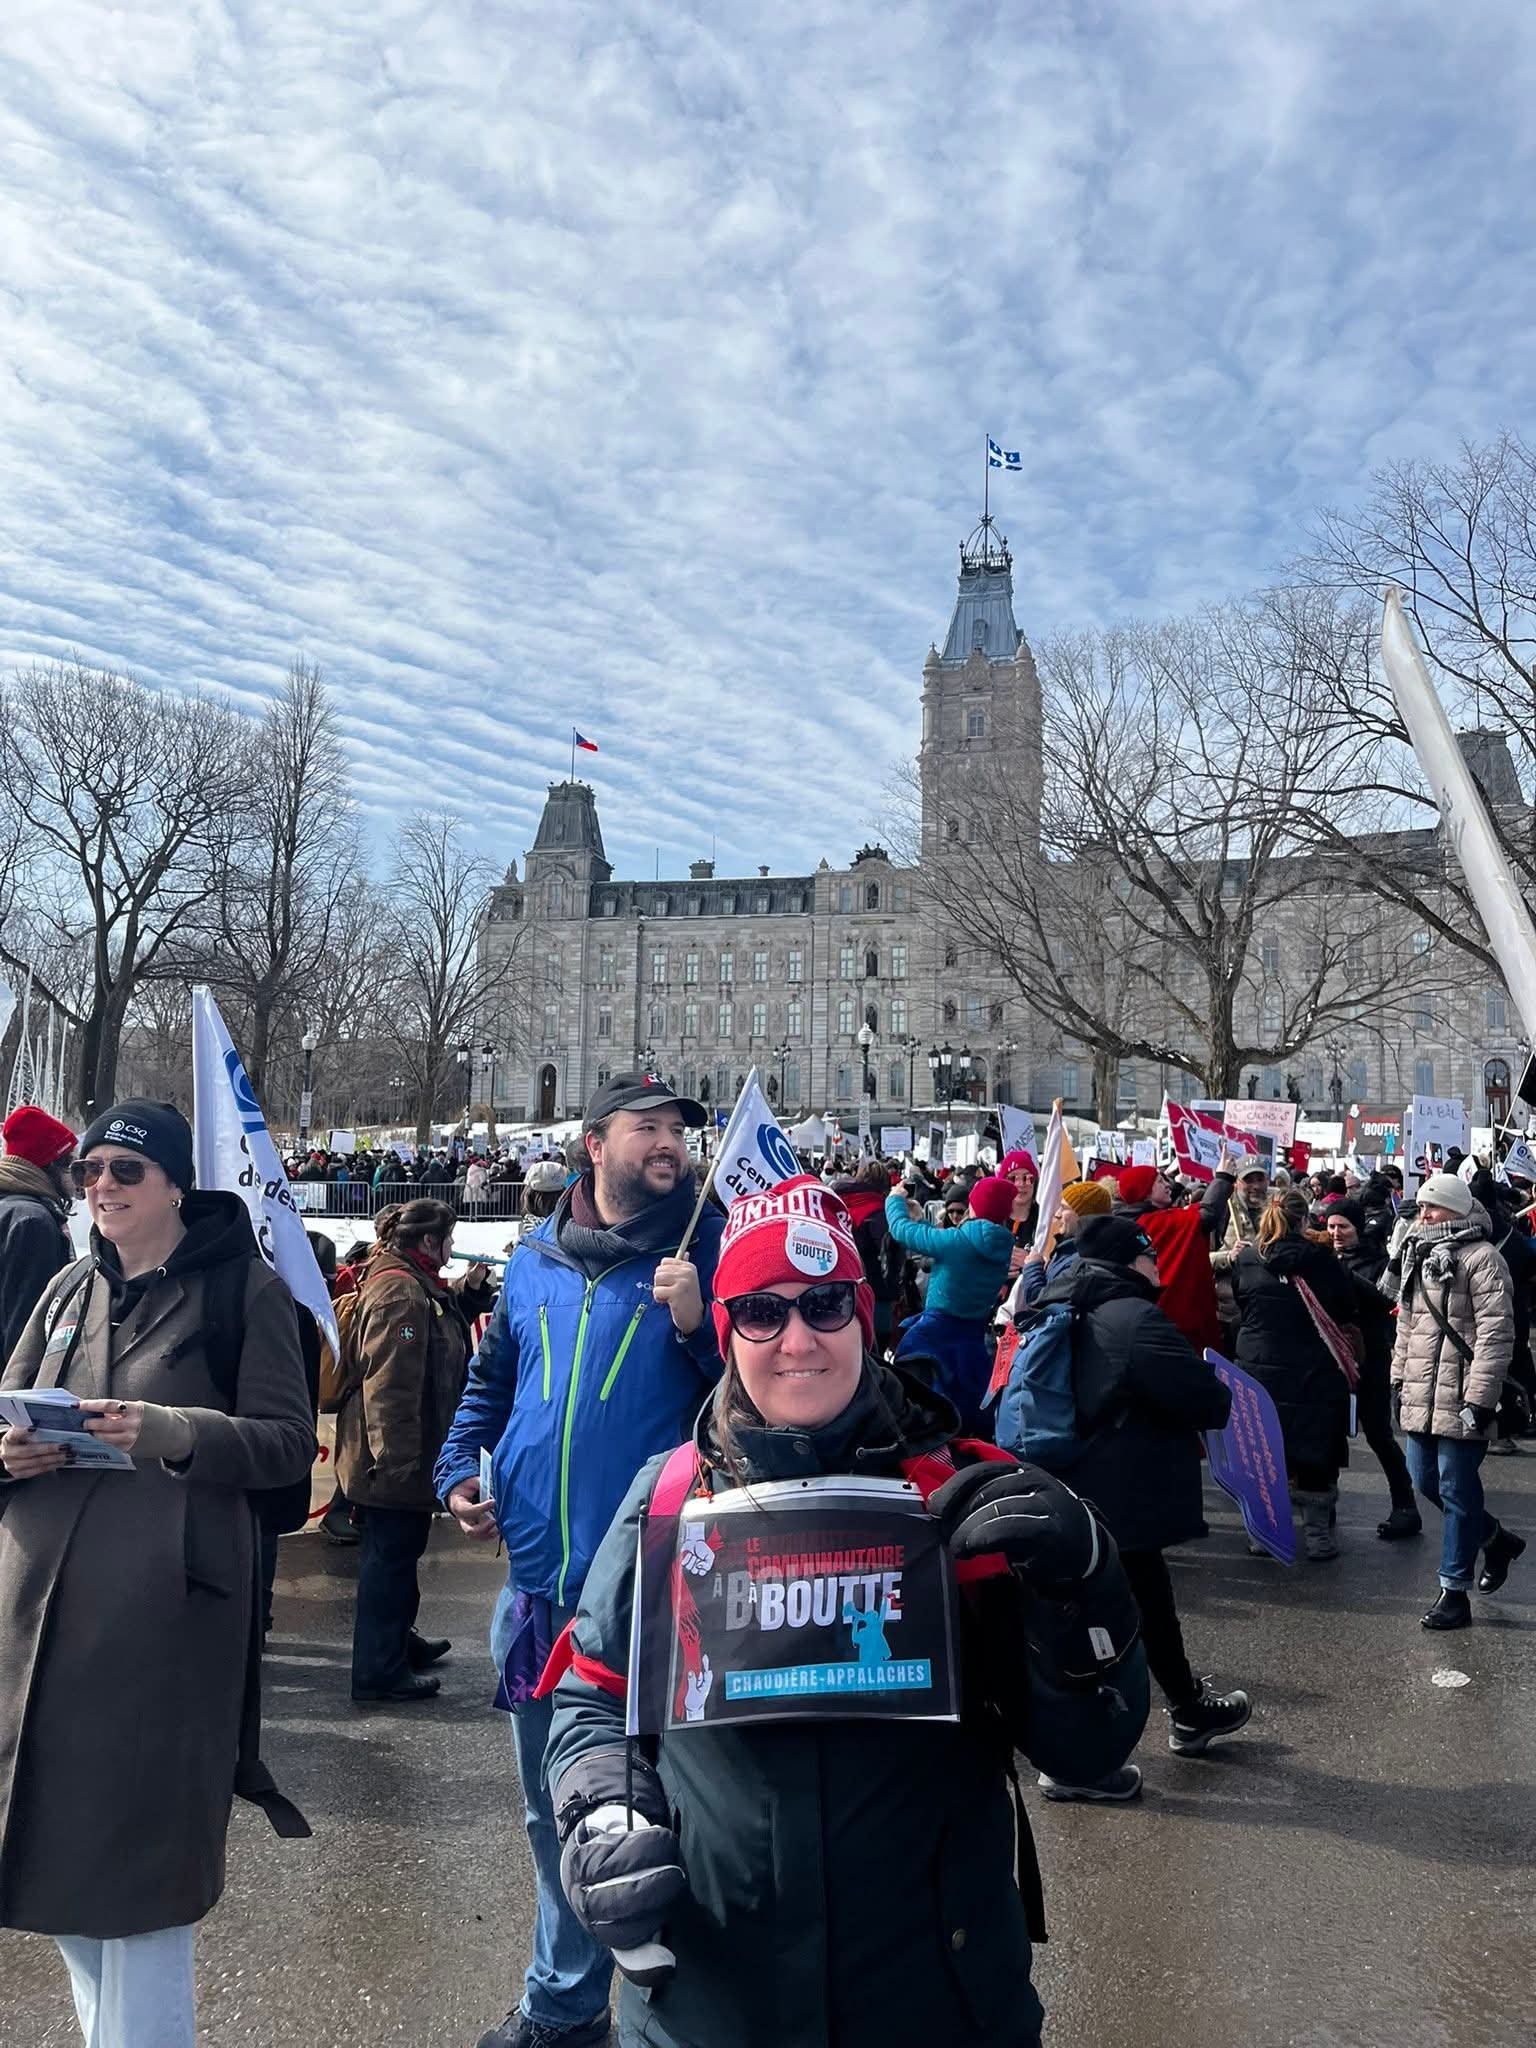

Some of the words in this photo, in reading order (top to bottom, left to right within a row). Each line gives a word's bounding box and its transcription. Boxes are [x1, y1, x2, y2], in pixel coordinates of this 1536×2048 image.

[125, 1124, 148, 1139] CSQ
[725, 1173, 749, 1197] du
[1252, 1450, 1278, 1529] bouger
[745, 1537, 761, 1553] LE
[747, 1545, 905, 1580] COMMUNAUTAIRE
[748, 1581, 758, 1604] À
[760, 1571, 903, 1632] BOUTTE
[732, 1664, 925, 1694] CHAUDIÈRE-APPALACHES
